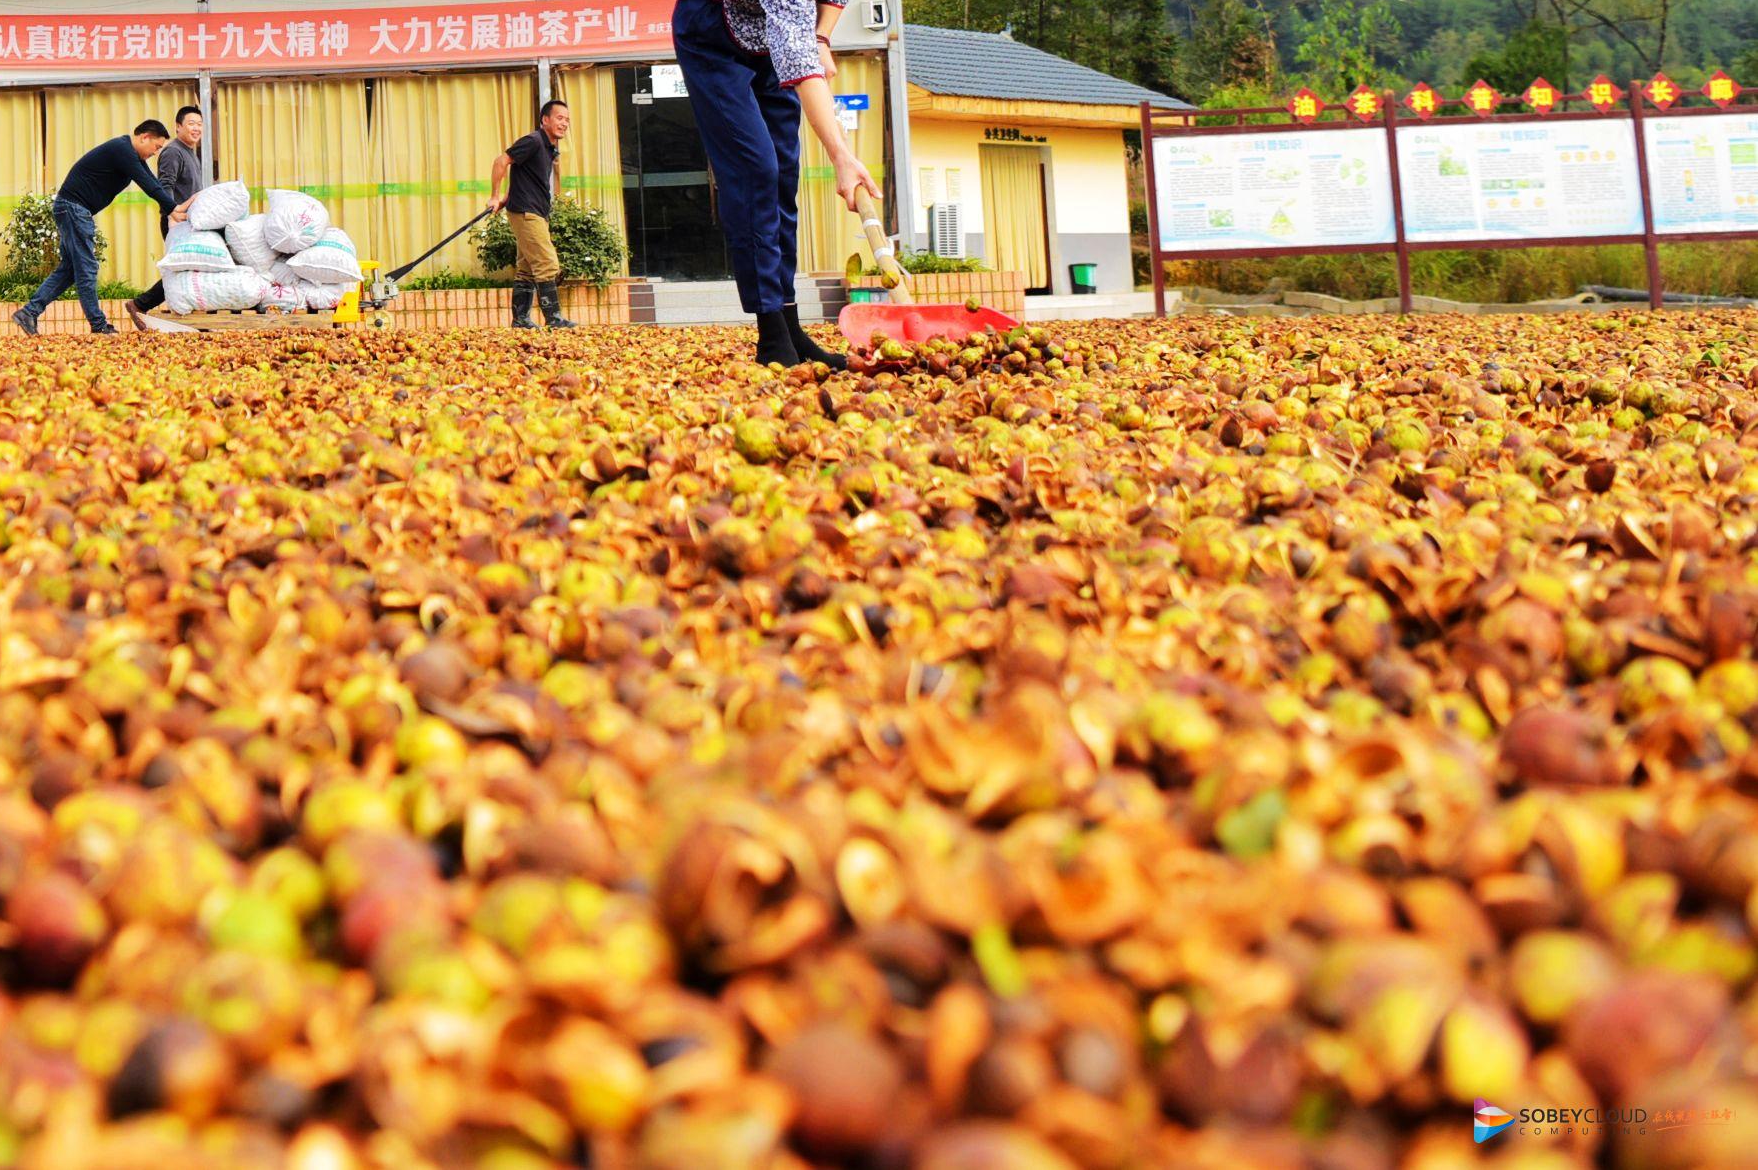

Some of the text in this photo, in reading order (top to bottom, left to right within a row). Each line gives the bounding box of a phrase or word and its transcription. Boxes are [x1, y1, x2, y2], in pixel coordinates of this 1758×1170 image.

[369, 5, 639, 55] 大力发展油茶产业
[1293, 77, 1734, 117] 油茶科普知识长廊
